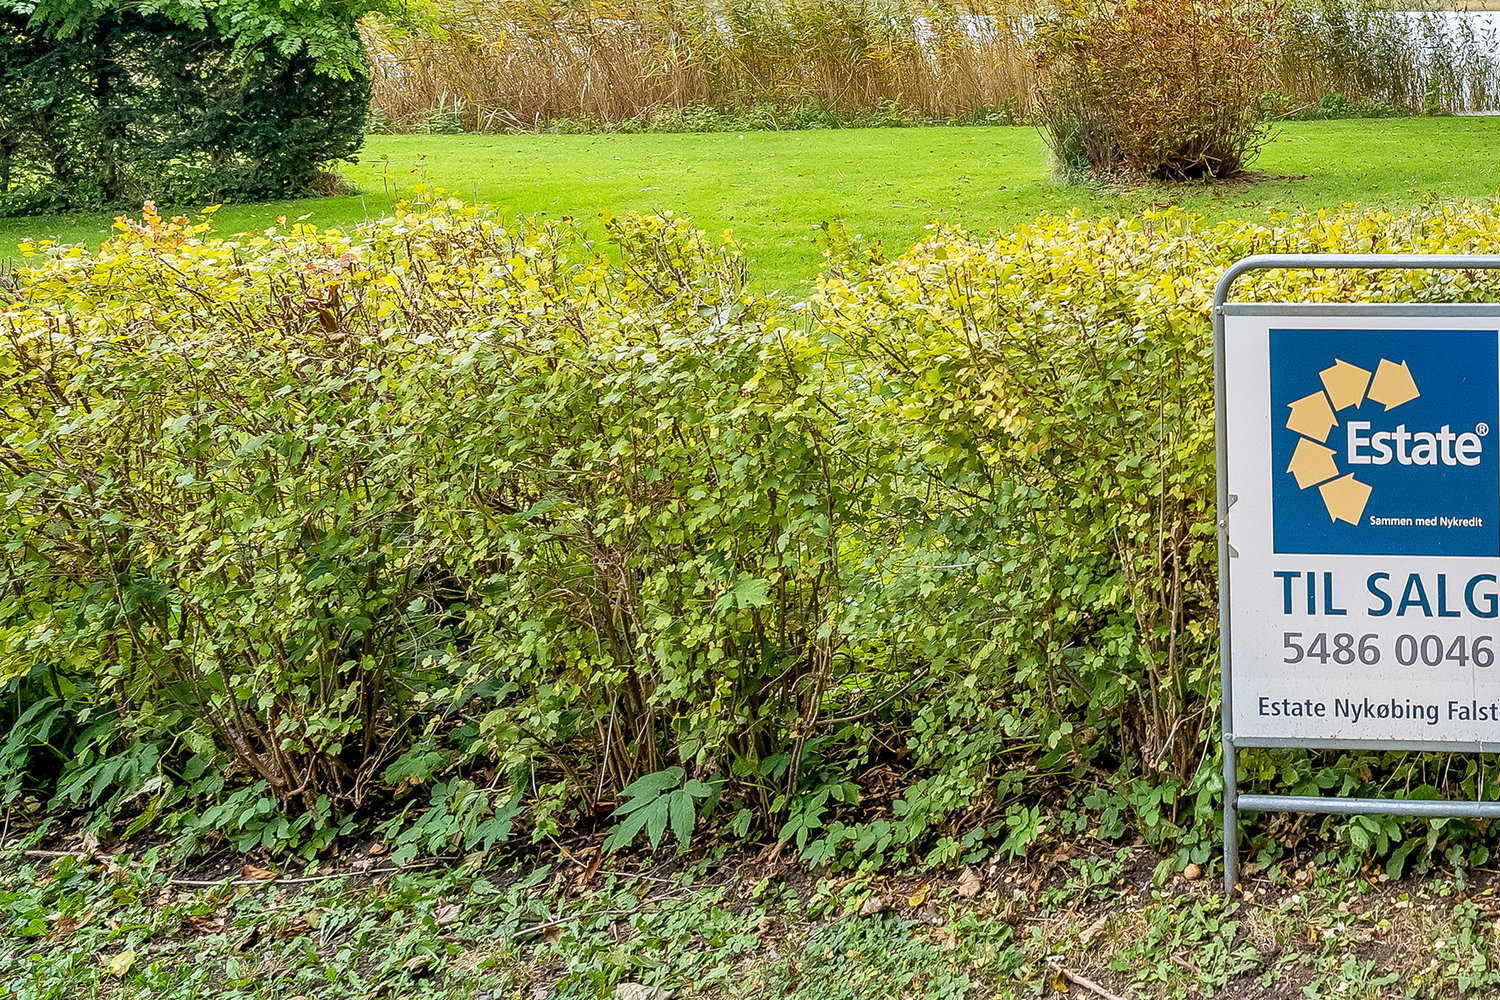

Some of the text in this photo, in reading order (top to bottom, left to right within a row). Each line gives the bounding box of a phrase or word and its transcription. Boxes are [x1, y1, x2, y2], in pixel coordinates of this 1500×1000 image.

[1370, 515, 1483, 529] Sammen med Nykredit
[1274, 571, 1500, 619] TIL SALG
[1283, 632, 1495, 667] 5486 0046
[1258, 697, 1326, 718] Estate
[1334, 698, 1439, 725] Nykøbing
